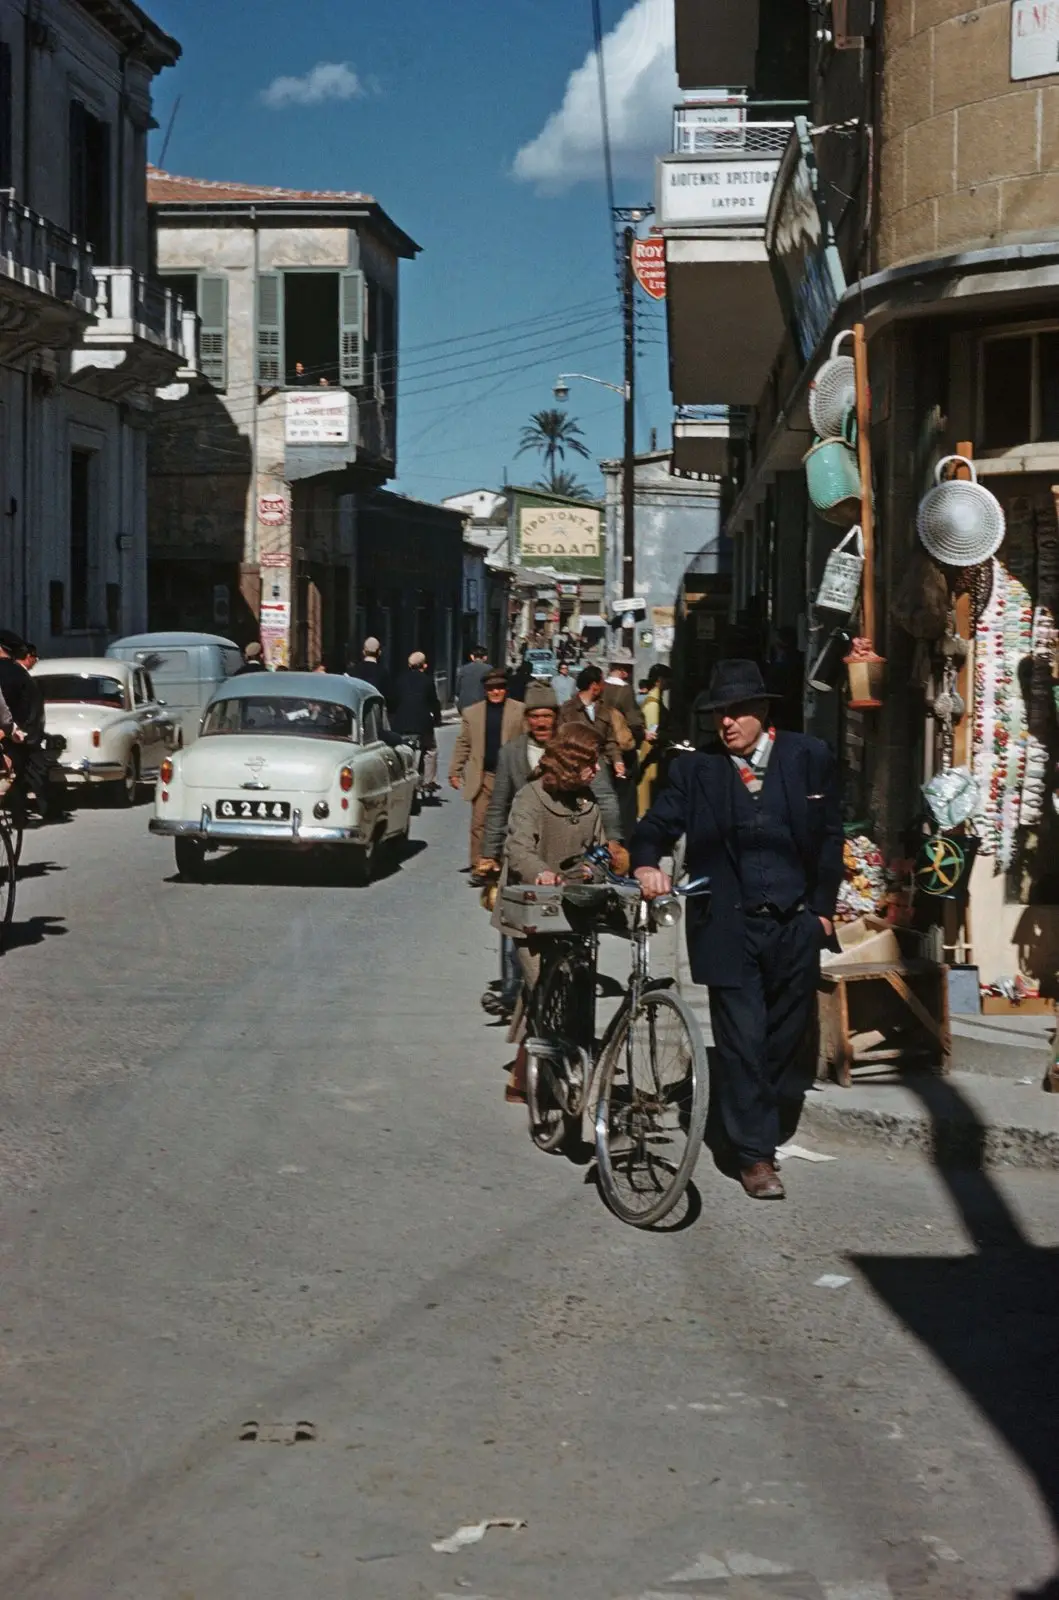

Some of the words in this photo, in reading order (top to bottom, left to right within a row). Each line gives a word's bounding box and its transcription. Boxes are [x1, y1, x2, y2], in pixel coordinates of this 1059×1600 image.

[712, 197, 755, 208] ΙΑΤΡΟΣ
[523, 543, 597, 554] ΣΟΔΑΠ
[241, 802, 283, 817] 244
